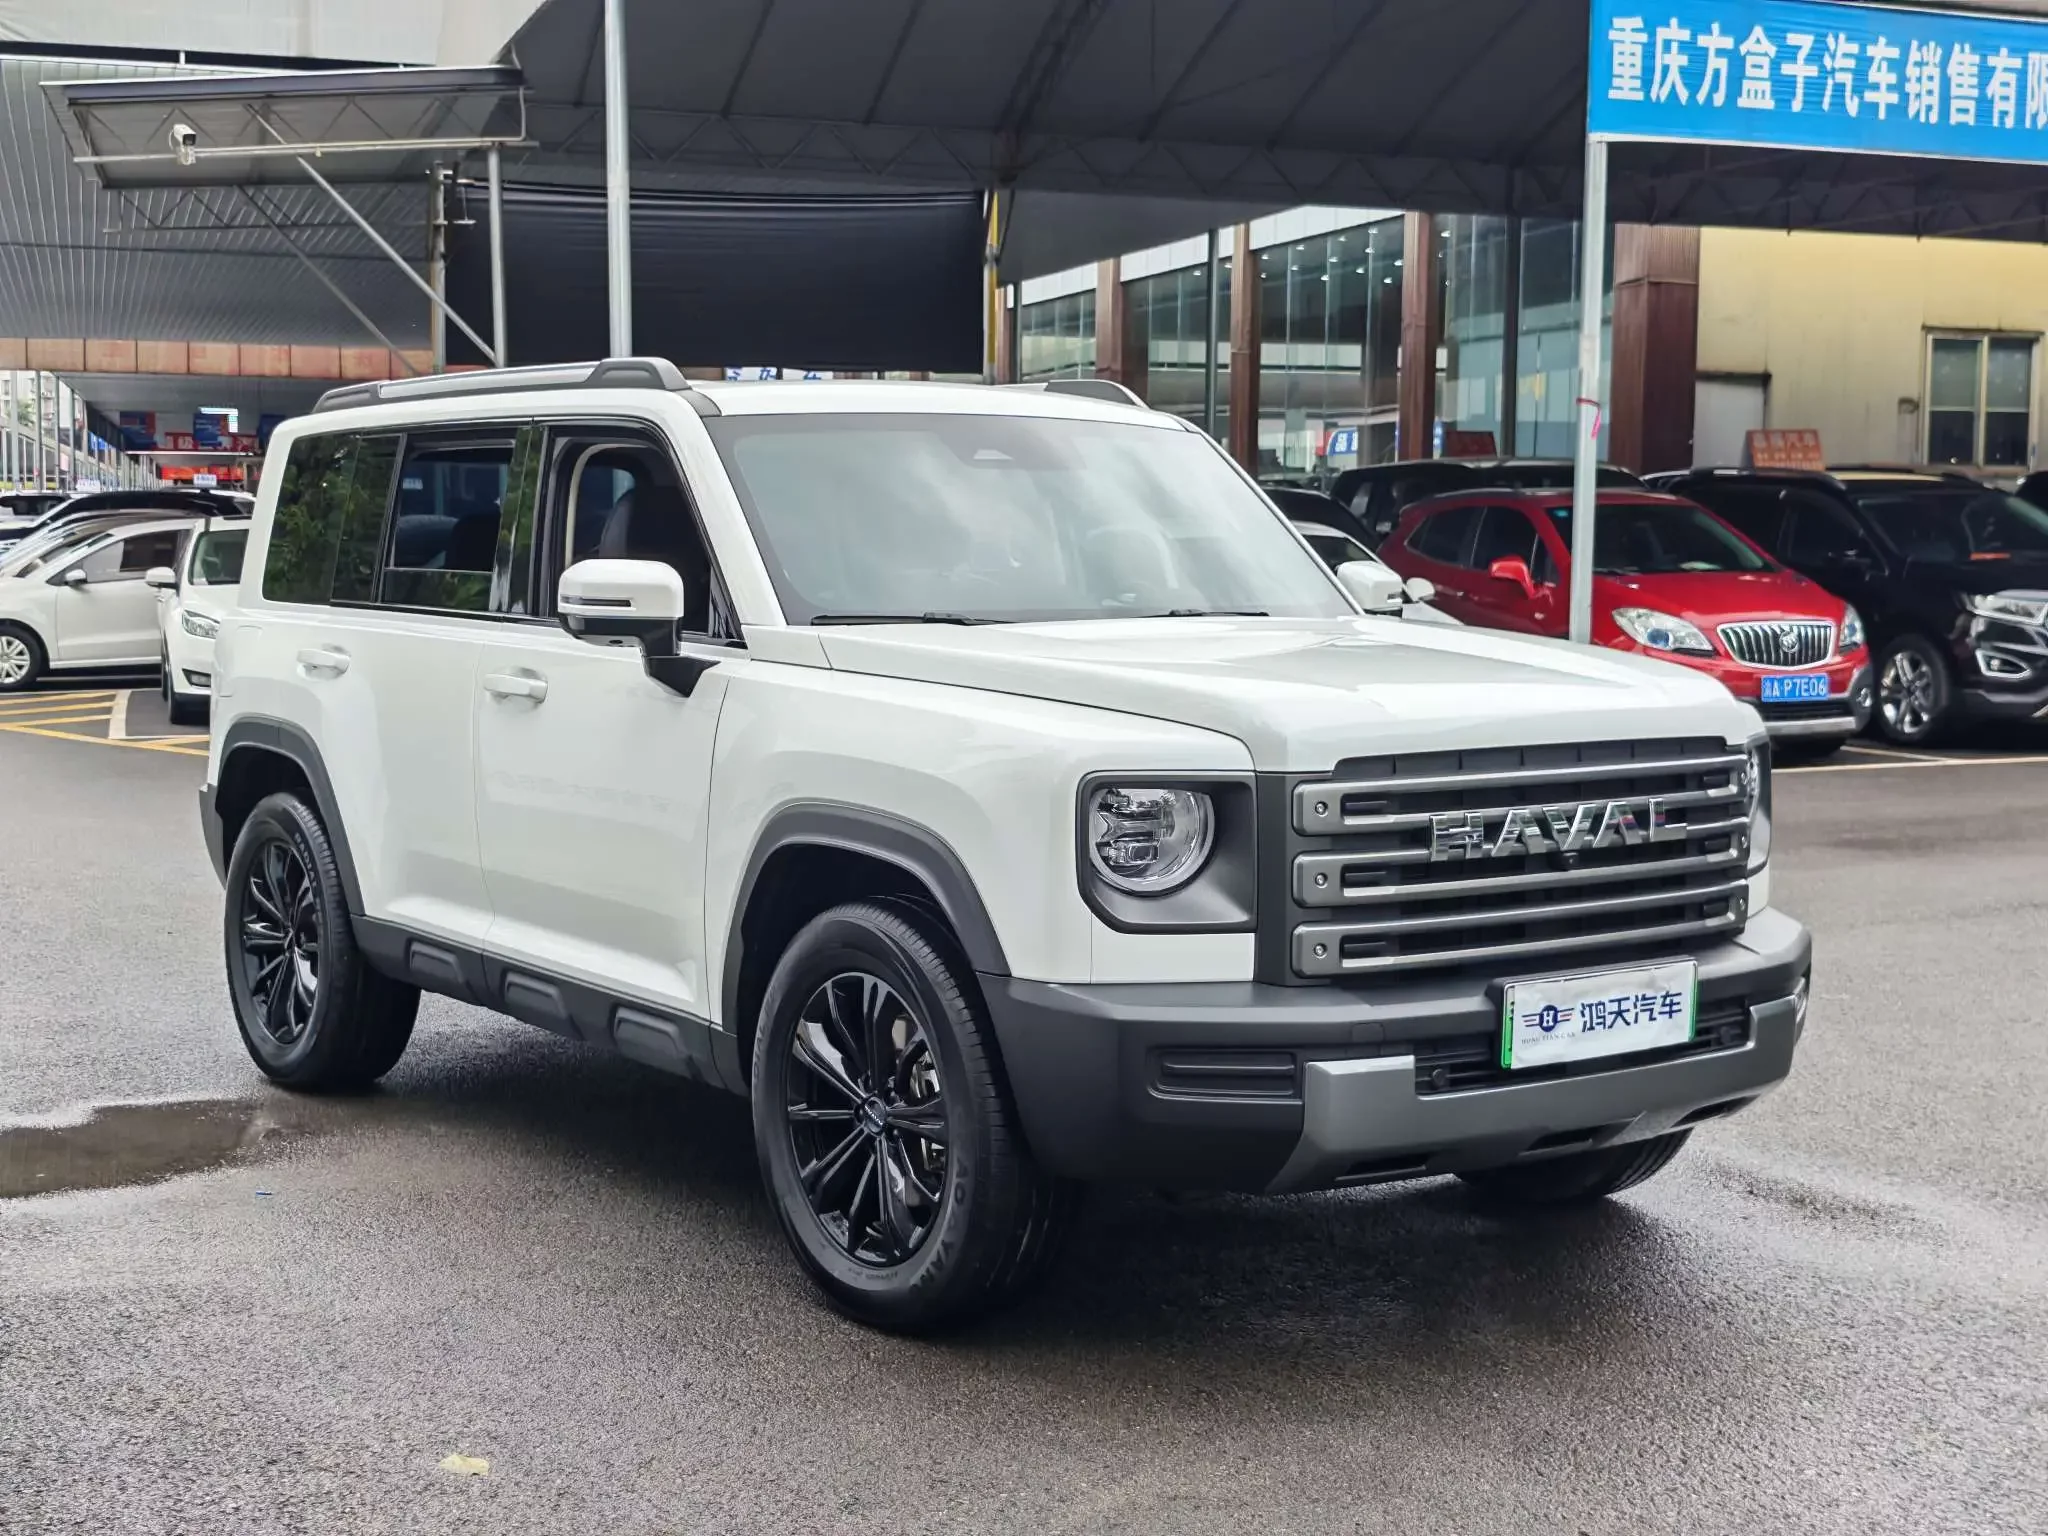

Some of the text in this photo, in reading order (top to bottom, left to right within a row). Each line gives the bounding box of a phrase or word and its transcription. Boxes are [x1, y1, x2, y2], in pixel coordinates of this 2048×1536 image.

[1608, 16, 2048, 130] 重庆方盒子汽车销售有限
[1430, 798, 1687, 861] HAVAL
[1579, 991, 1683, 1033] 鸿天汽车
